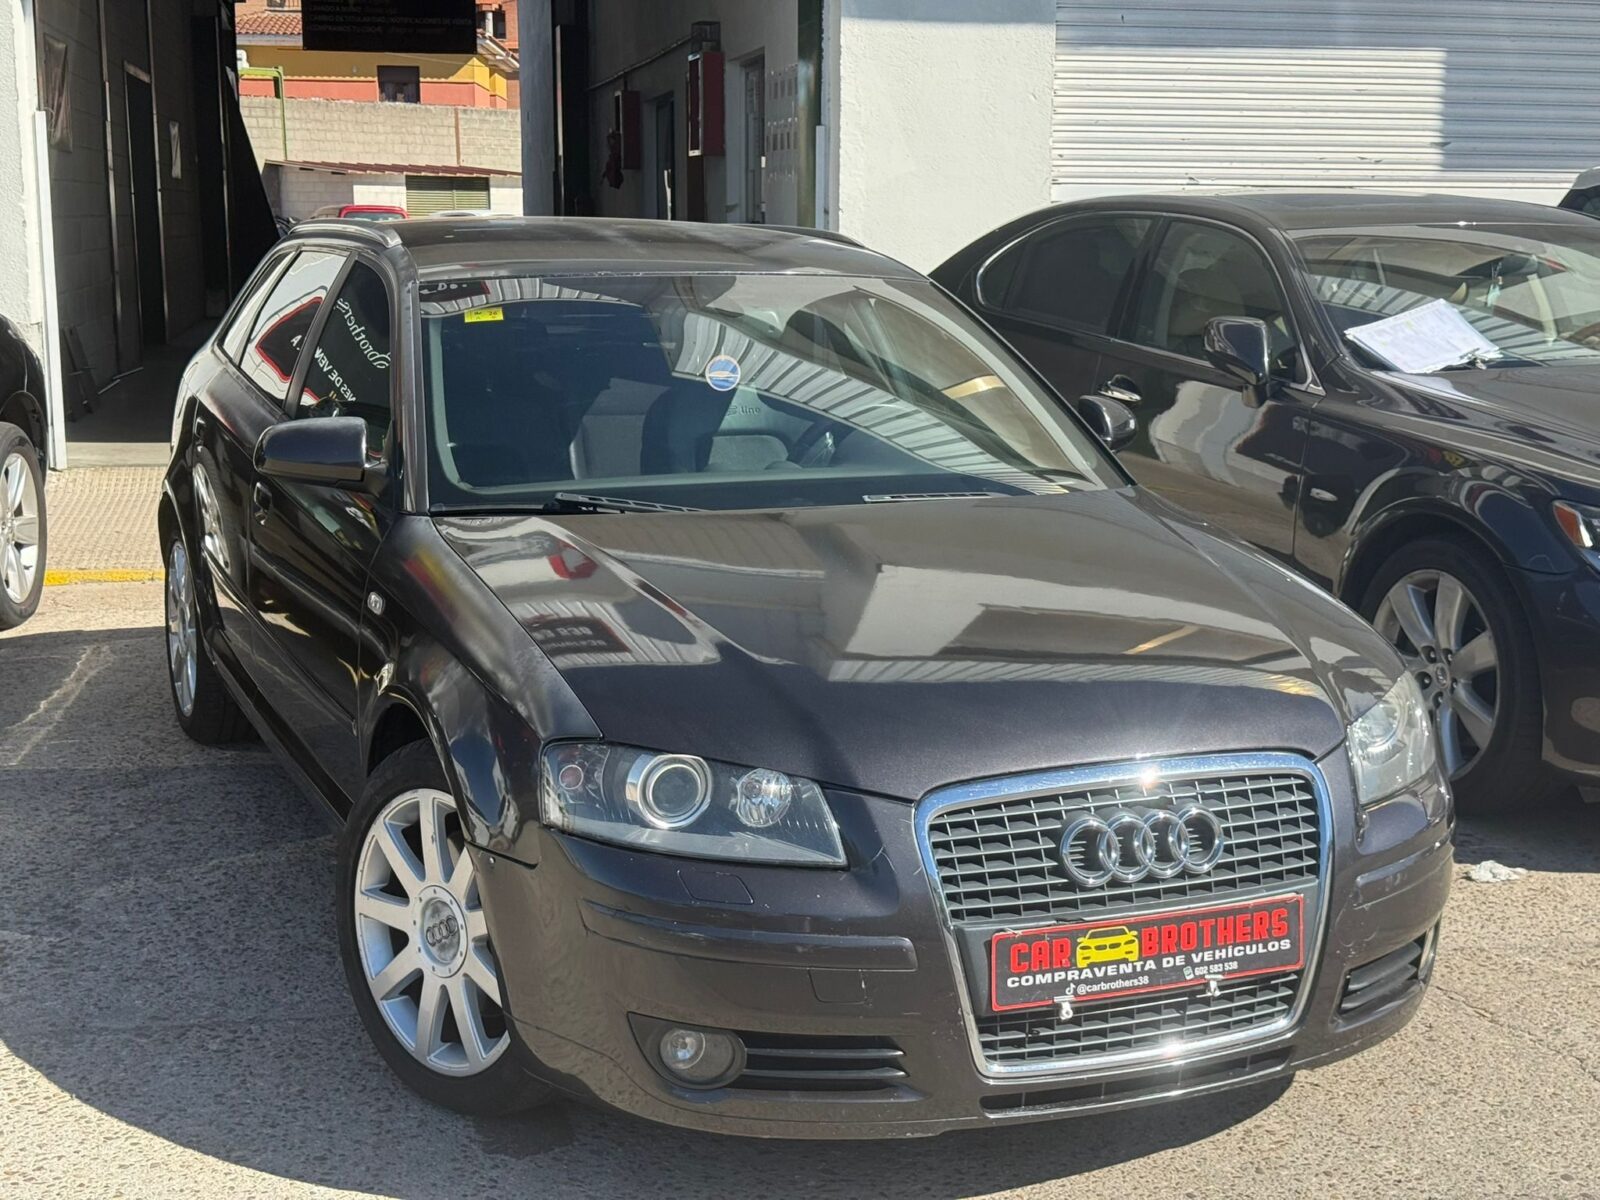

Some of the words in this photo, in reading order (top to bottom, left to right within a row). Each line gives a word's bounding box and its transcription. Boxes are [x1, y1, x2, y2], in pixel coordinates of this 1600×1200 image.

[1006, 958, 1157, 988] COMPRAVENTA
[1162, 955, 1186, 968] DE
[1191, 939, 1291, 964] VEHÍCULOS
[1009, 937, 1072, 973] CAR
[1141, 907, 1288, 958] BROTHERS
[1076, 975, 1150, 996] @carbrothers38
